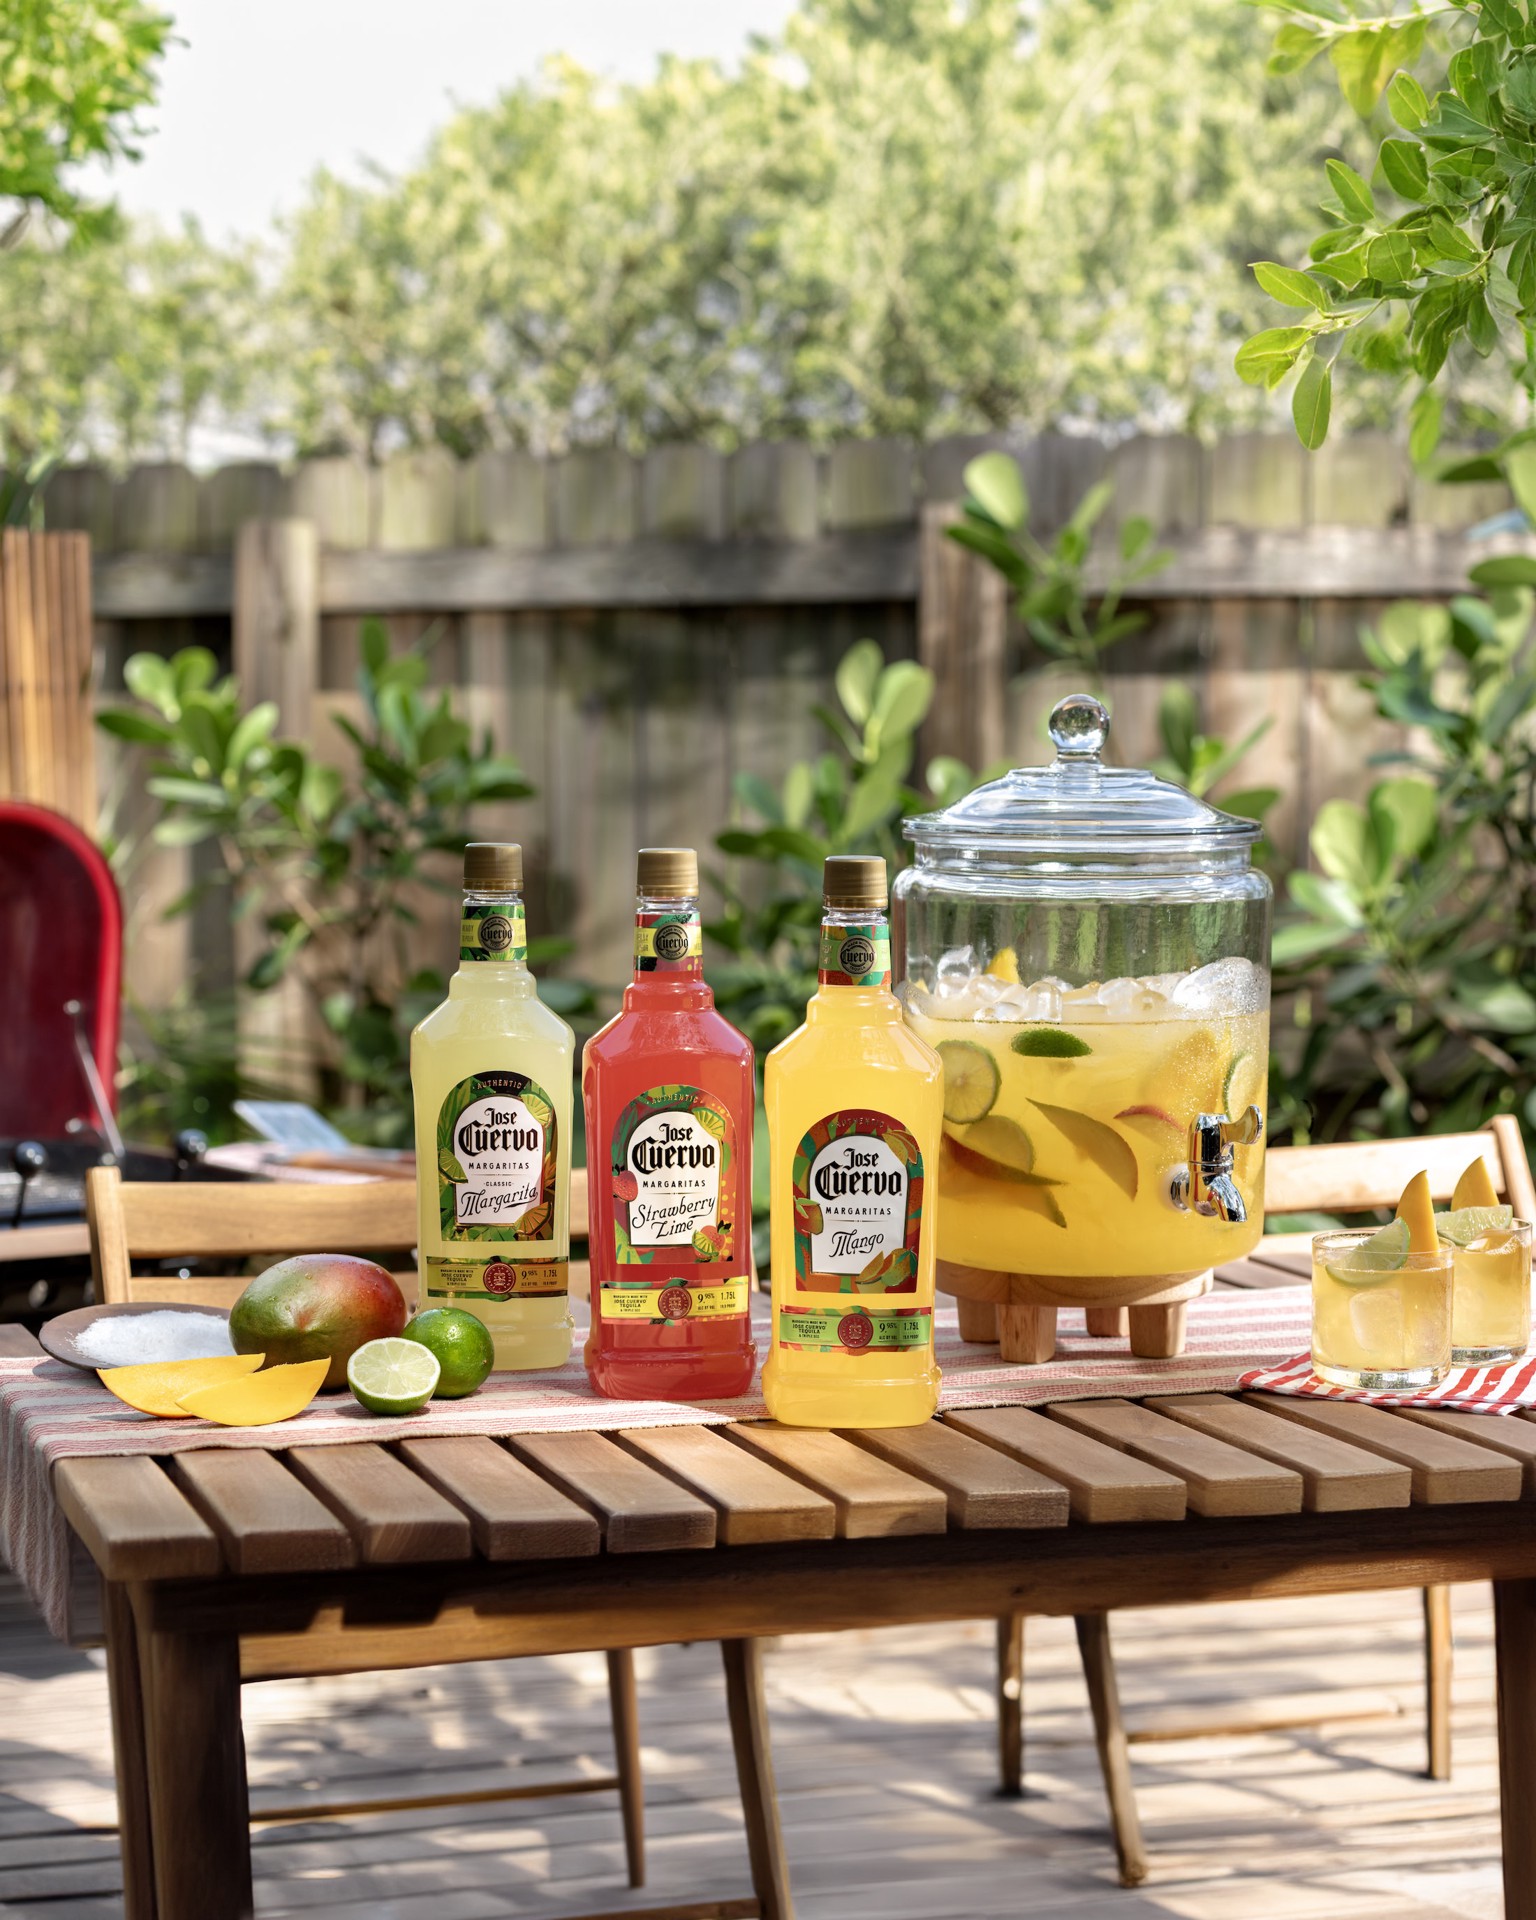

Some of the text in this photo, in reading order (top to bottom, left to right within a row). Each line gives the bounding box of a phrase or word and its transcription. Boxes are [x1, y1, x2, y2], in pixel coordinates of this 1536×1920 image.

[480, 926, 512, 941] Cuervo
[656, 936, 688, 950] Cuervo
[840, 948, 875, 964] Cuervo
[477, 1079, 522, 1090] AUTHENTIC
[652, 1093, 698, 1104] AUTHENTIC
[484, 1107, 518, 1128] Jose
[458, 1120, 539, 1156] Cuervo
[658, 1123, 693, 1145] Jose
[632, 1136, 716, 1175] Cuervo
[843, 1148, 879, 1170] Jose
[468, 1162, 530, 1170] MARGARITAS
[642, 1180, 706, 1188] MARGARITAS
[814, 1160, 902, 1200] Cuervo
[458, 1182, 538, 1218] Margarita
[632, 1196, 716, 1228] Strawberry
[826, 1206, 892, 1215] MARGARITAS
[650, 1220, 694, 1239] Lime
[828, 1229, 884, 1258] Mango
[720, 1291, 736, 1300] 1.75L
